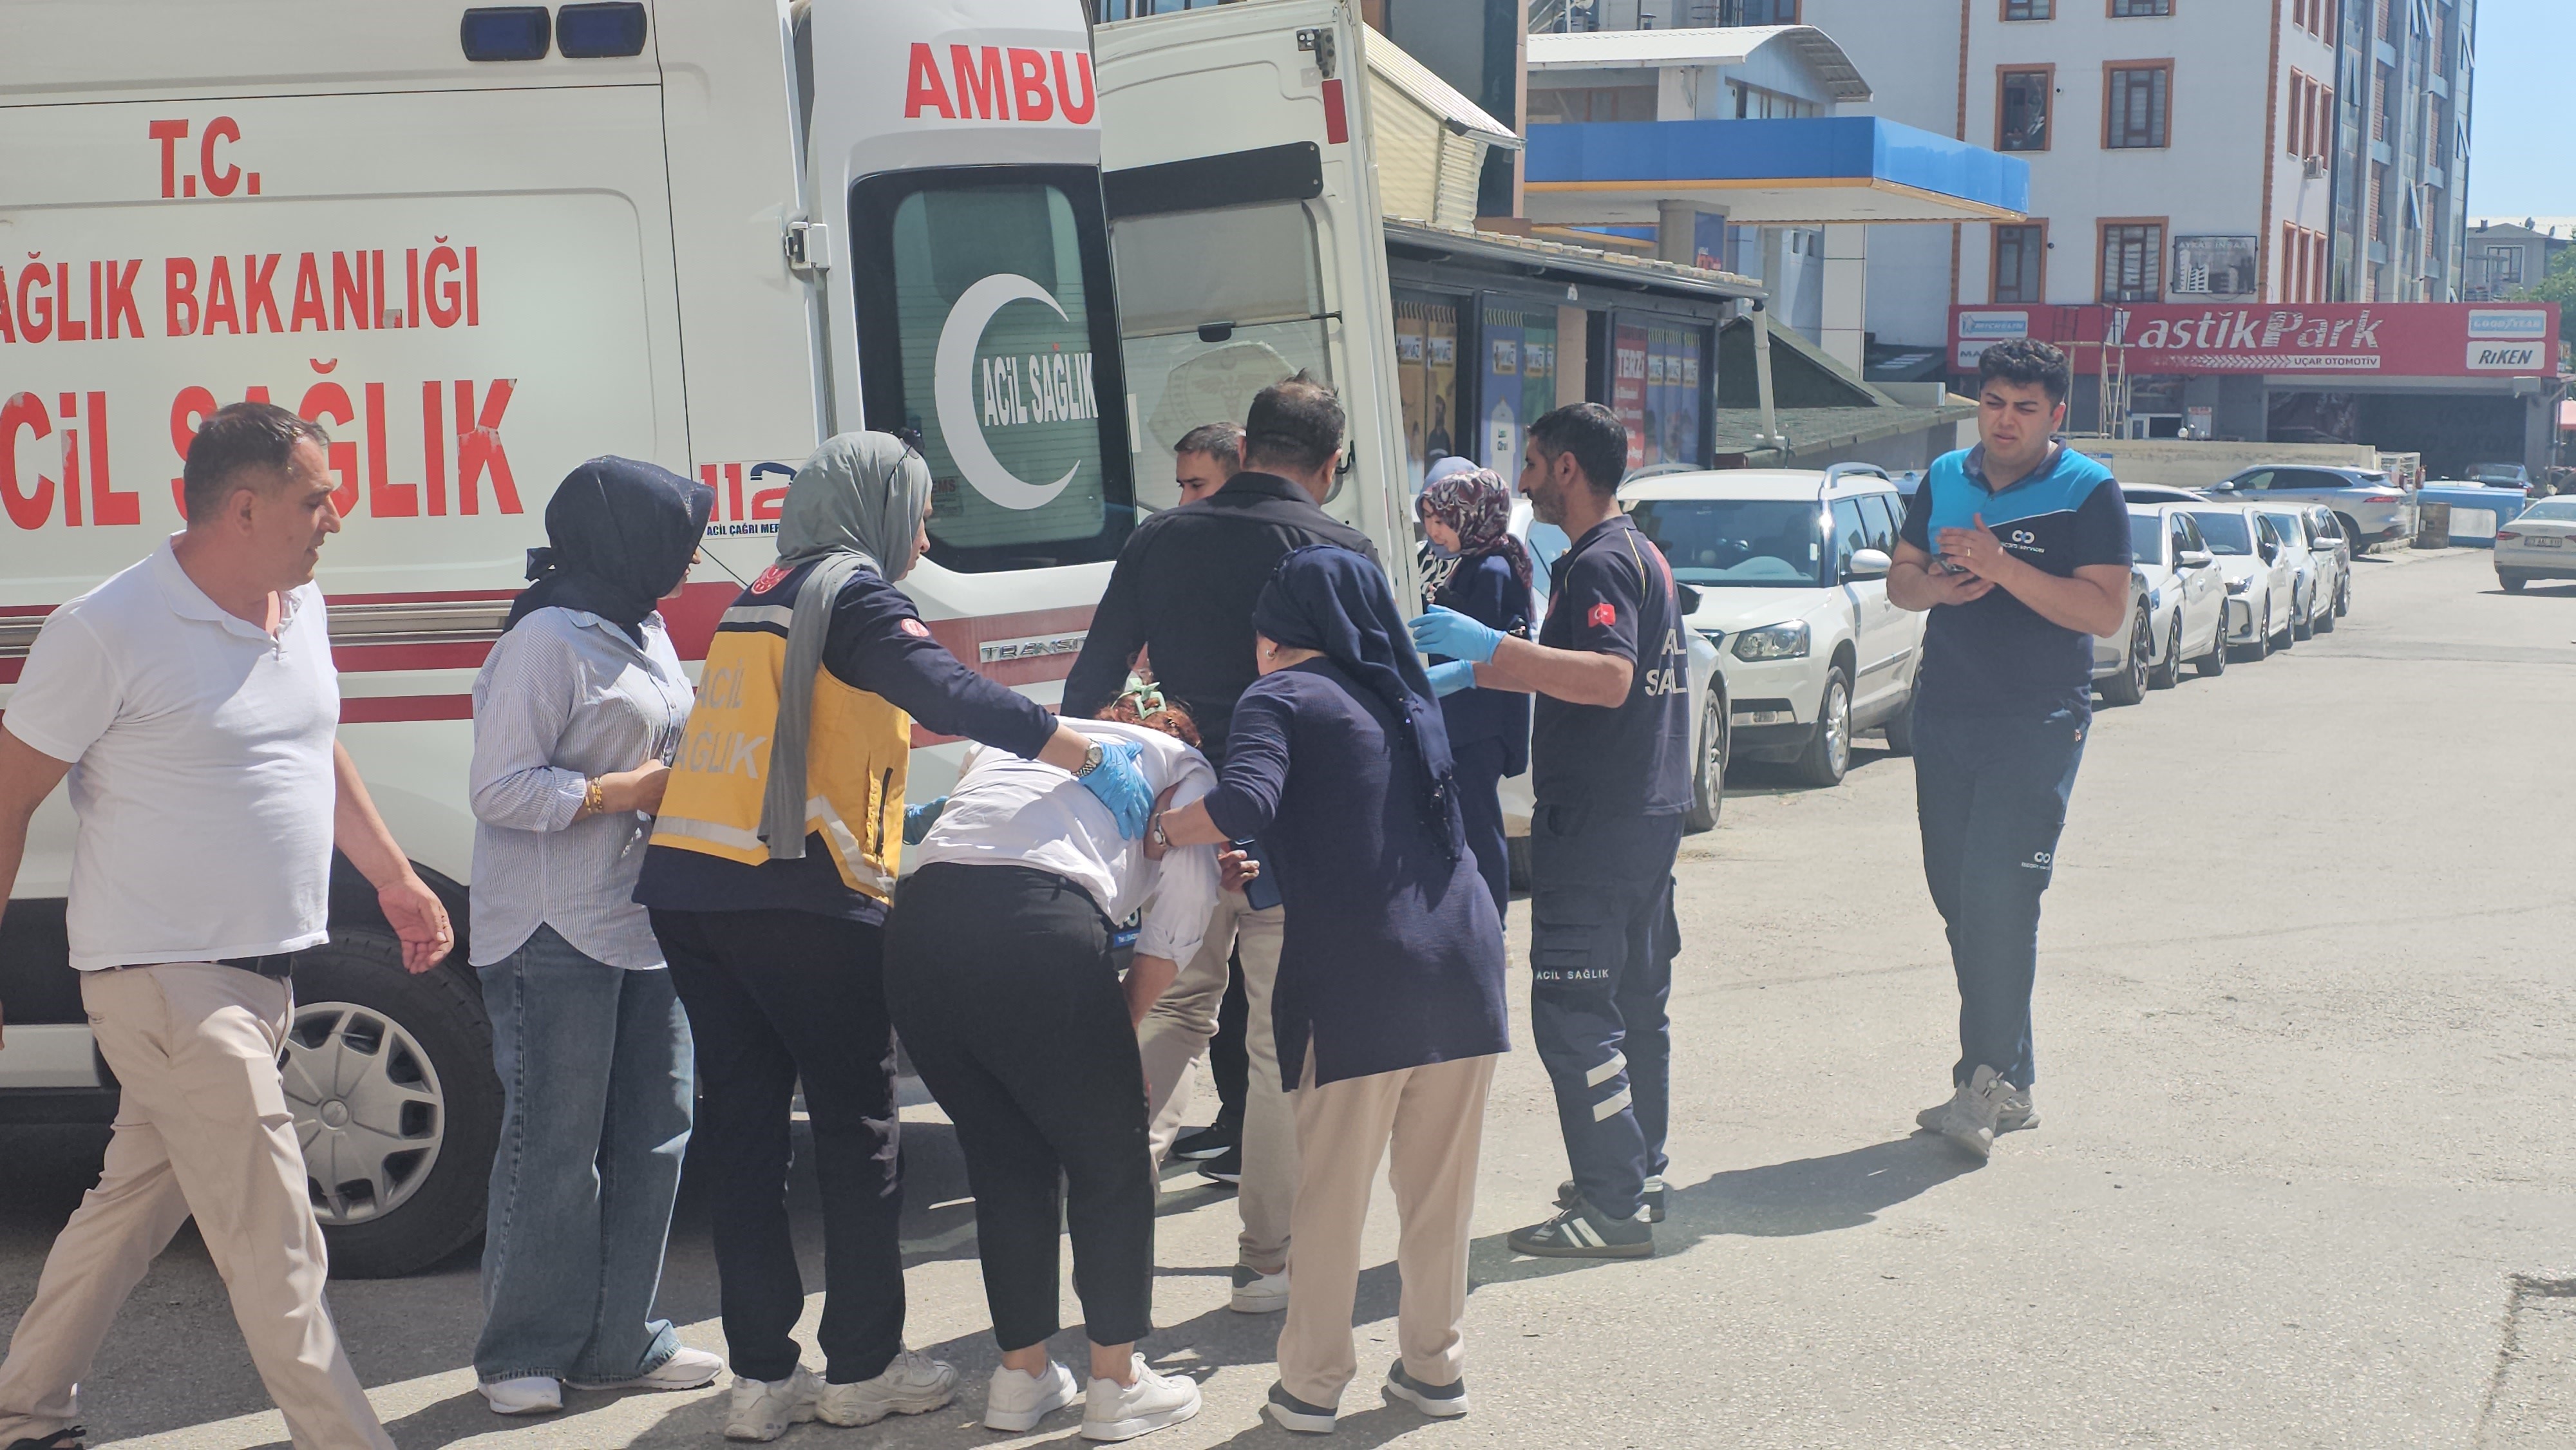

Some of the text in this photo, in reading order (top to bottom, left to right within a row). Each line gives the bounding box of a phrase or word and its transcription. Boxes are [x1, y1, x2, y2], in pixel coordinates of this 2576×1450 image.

[904, 42, 1095, 125] AMBU
[149, 115, 261, 198] T.C.
[166, 234, 479, 337] BAKANLIĞI
[2294, 357, 2322, 366] UÇAR
